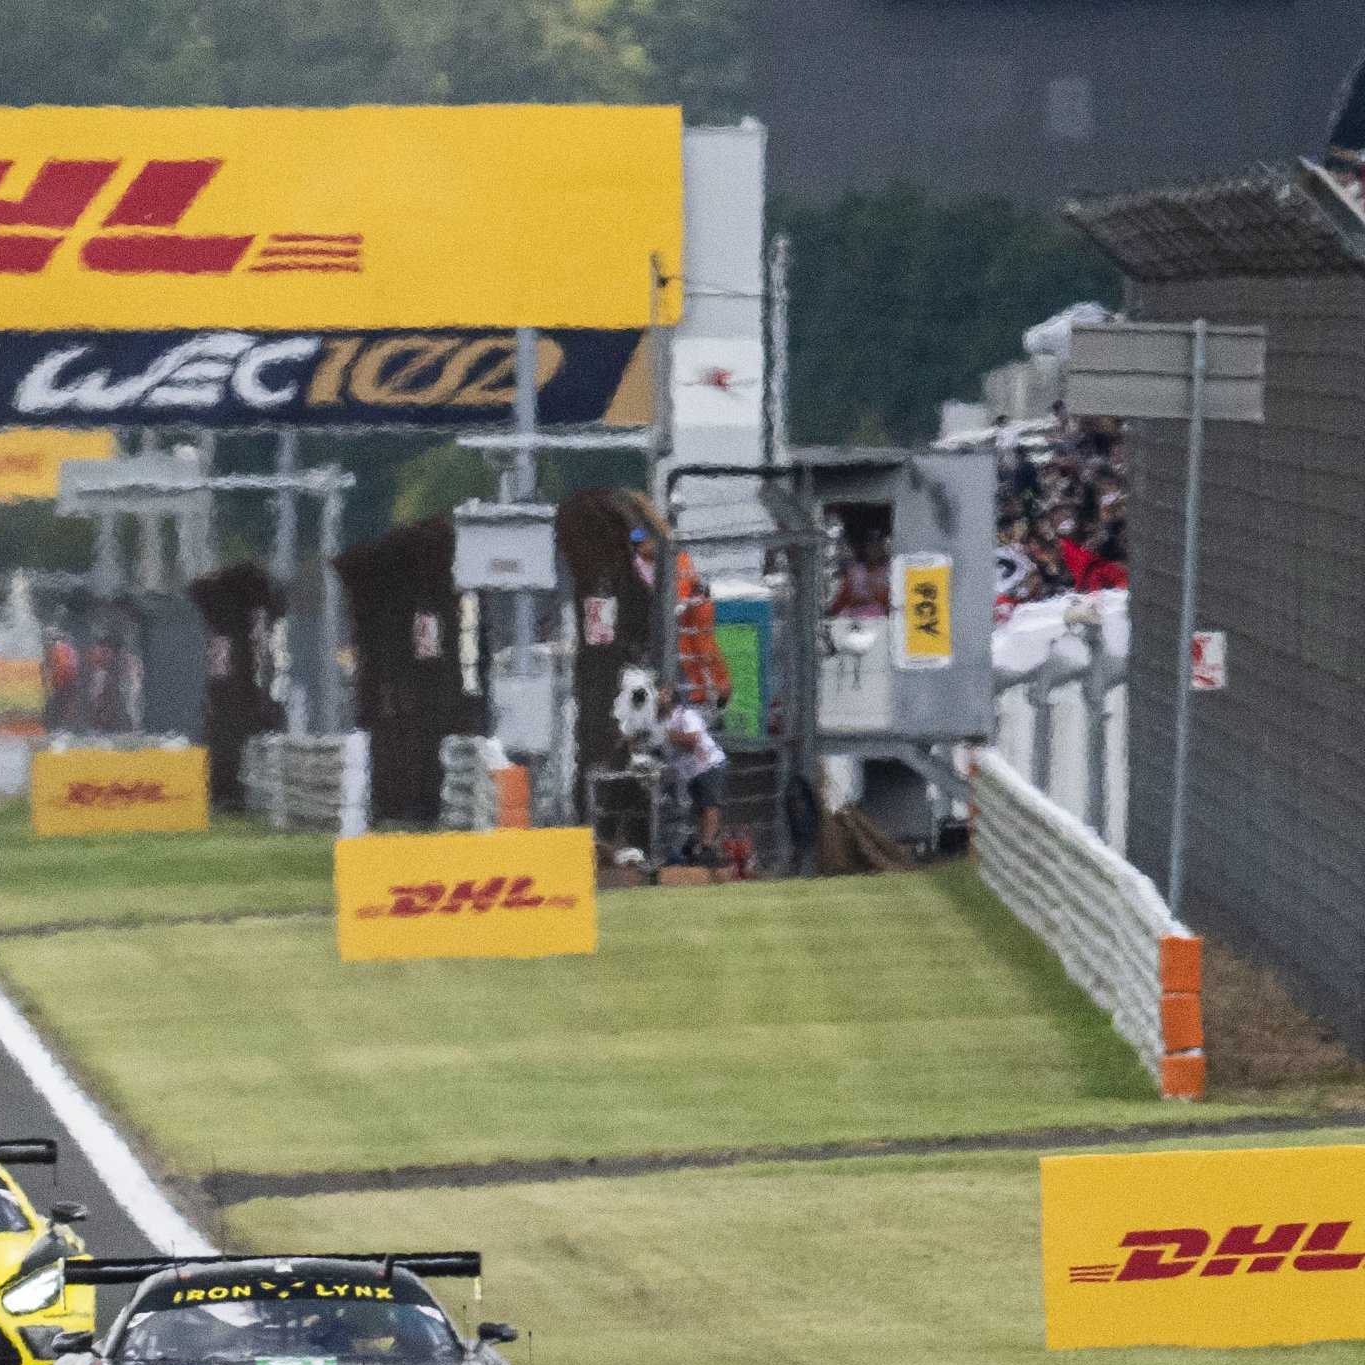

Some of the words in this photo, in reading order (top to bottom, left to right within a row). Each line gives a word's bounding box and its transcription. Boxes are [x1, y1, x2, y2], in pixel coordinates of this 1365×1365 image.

[12, 333, 323, 414] WEC
[912, 580, 940, 637] FCY
[68, 780, 165, 805] DHL
[387, 876, 545, 918] DHL
[1115, 1221, 1365, 1282] DHL
[173, 1284, 251, 1304] IRON
[315, 1284, 394, 1299] LYNX
